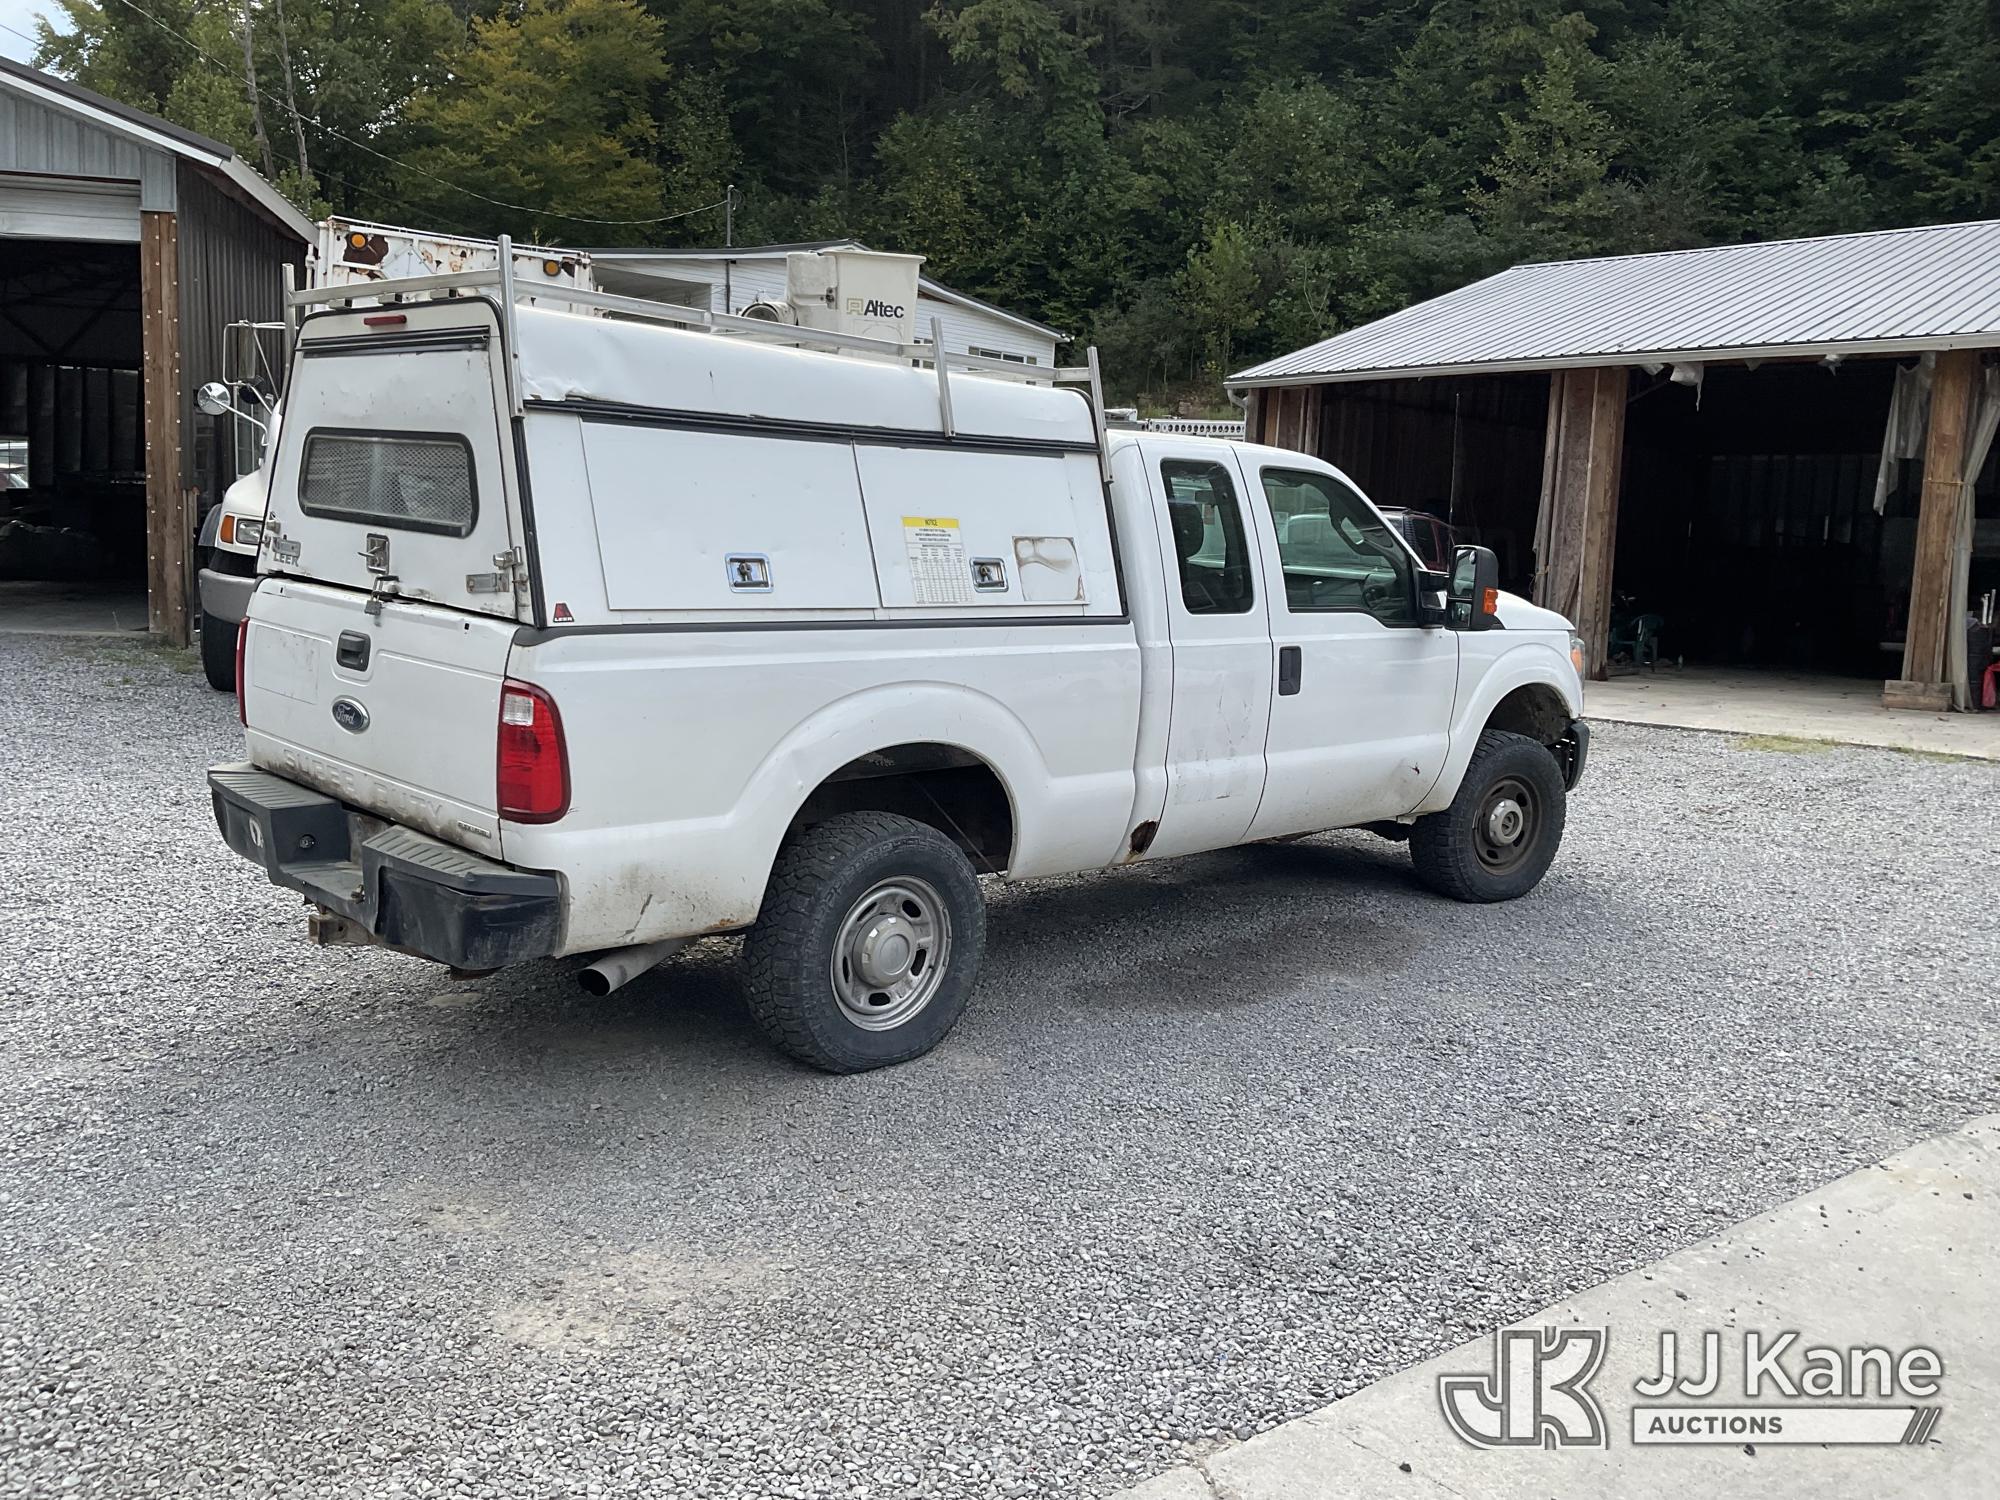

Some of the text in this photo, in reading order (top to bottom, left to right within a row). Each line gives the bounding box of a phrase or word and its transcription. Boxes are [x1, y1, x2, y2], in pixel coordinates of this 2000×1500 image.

[864, 299, 904, 319] Altec
[273, 551, 299, 567] LEER
[336, 703, 356, 725] Ford
